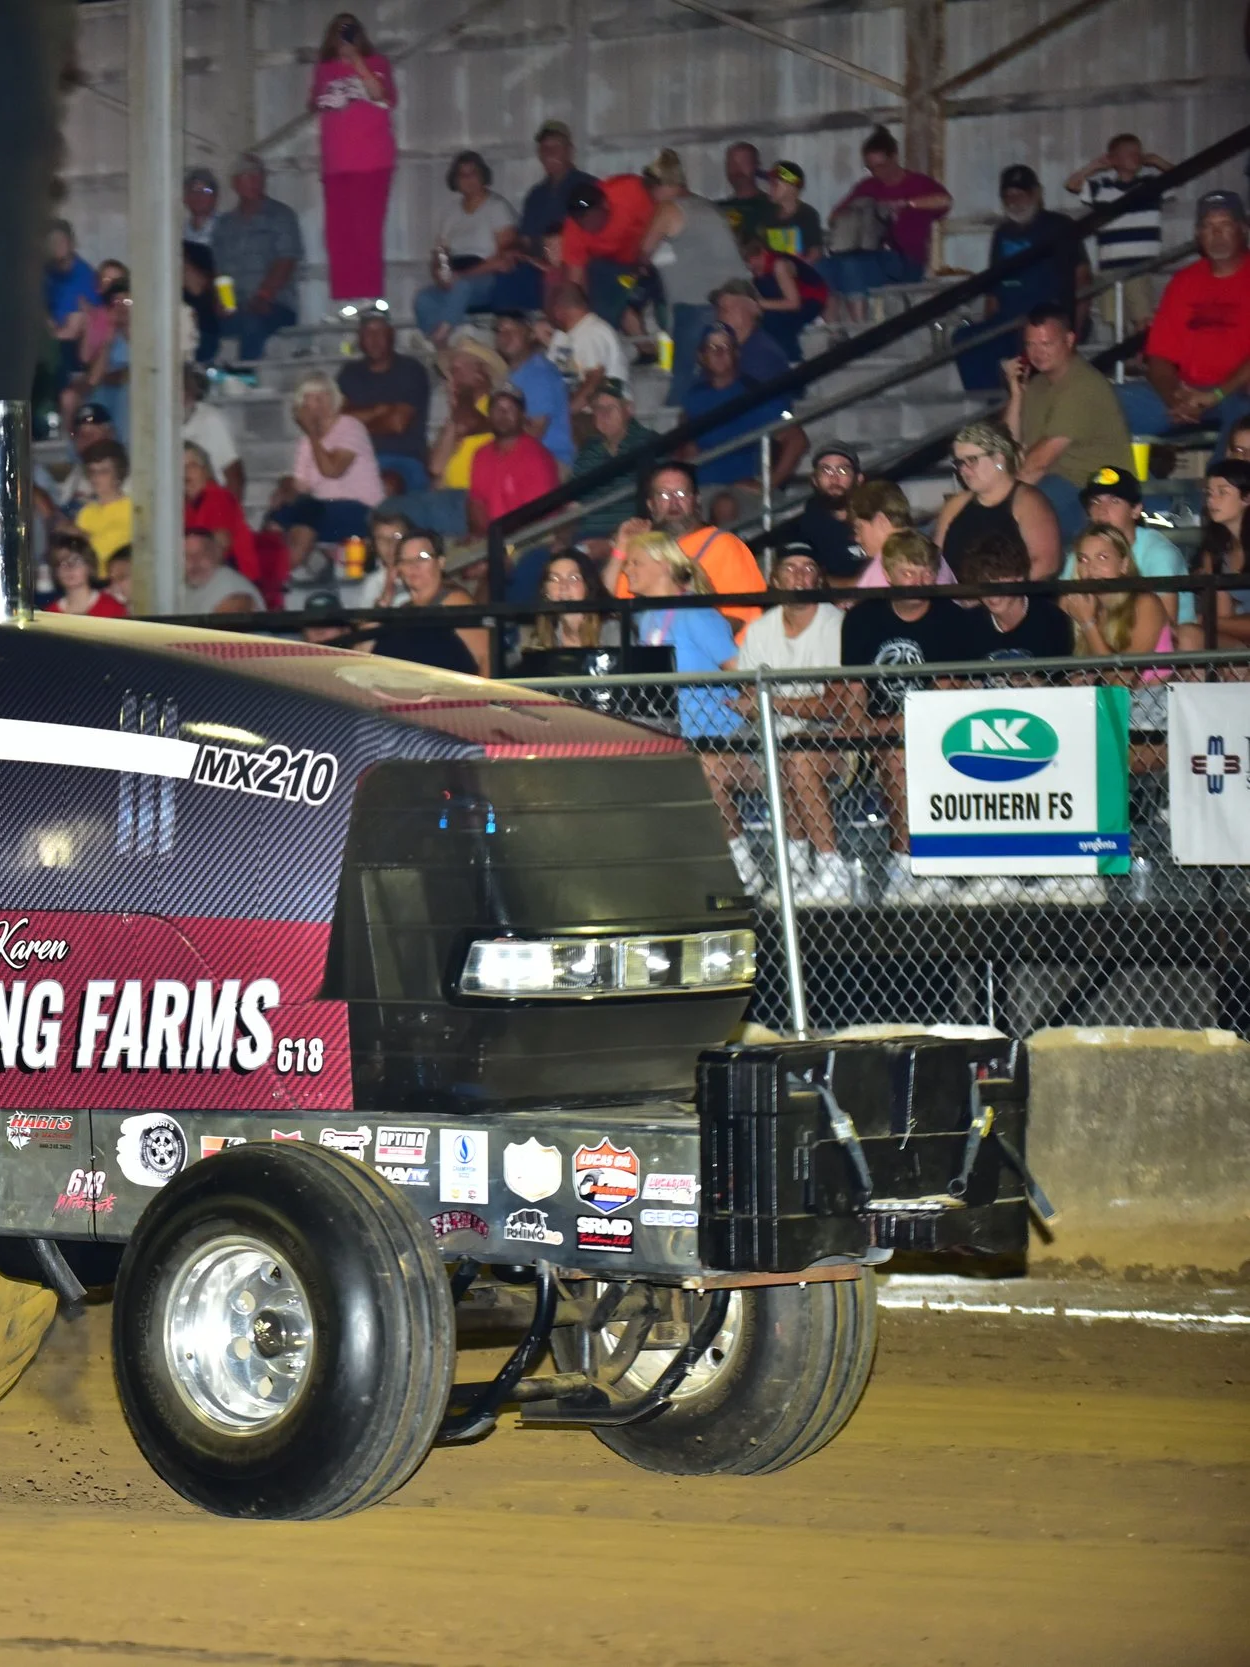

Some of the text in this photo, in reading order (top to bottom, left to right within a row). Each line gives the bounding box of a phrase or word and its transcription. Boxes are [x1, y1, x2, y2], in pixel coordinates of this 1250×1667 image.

[970, 717, 1031, 750] NK
[197, 747, 338, 804] MX210
[930, 791, 1073, 821] SOUTHERN FS
[75, 977, 281, 1071] FARMS
[276, 1037, 324, 1073] 618
[10, 1113, 73, 1131] HARTS
[379, 1131, 424, 1147] OPTIMA
[579, 1153, 632, 1168] LUCAS OIL
[66, 1168, 106, 1199] 618
[576, 1217, 632, 1236] SRMD
[644, 1211, 696, 1225] GEICO
[506, 1227, 545, 1240] RHINO
